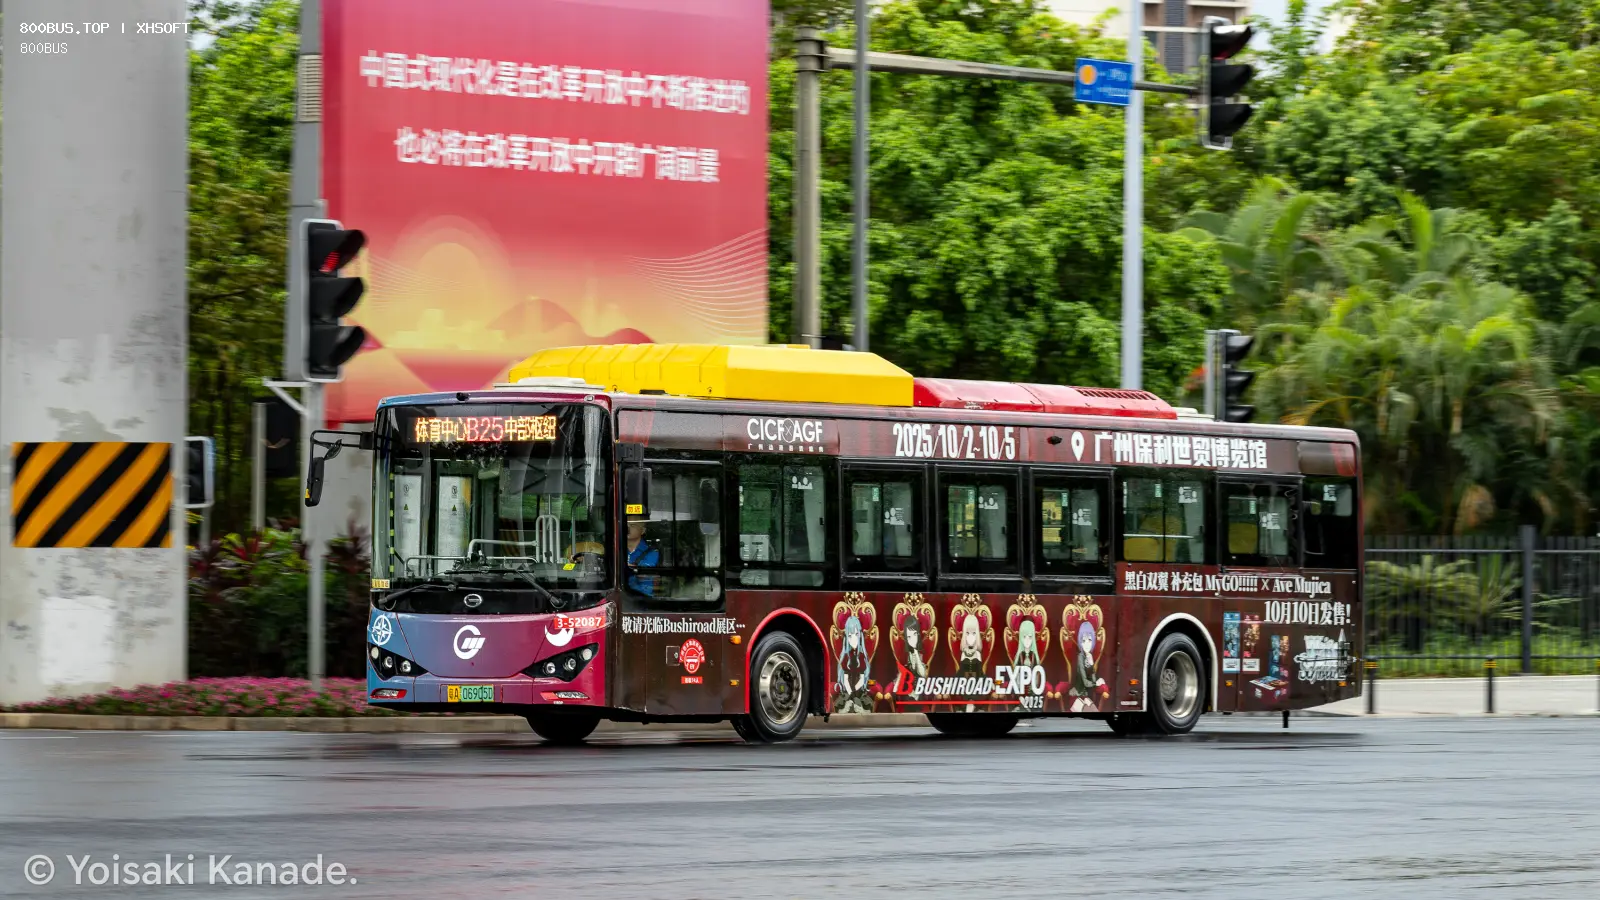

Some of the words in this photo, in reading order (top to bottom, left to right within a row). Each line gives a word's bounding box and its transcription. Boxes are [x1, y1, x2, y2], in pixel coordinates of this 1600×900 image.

[359, 50, 751, 115] 中国式现代化是在改革开放中不断推进的
[892, 422, 1016, 460] 2025/10/2~10/5
[1094, 431, 1268, 469] 广州保利世贸博览馆
[1124, 570, 1169, 592] 黑白双翼
[1171, 571, 1204, 592] 补充包
[1205, 574, 1258, 596] MyGO!!!!!
[1272, 577, 1293, 593] Ave
[1294, 576, 1332, 599] Mujica
[557, 616, 602, 629] 3-52087
[915, 676, 993, 696] BUSHIROAD
[995, 664, 1046, 696] EXPO
[1023, 695, 1044, 709] 2025
